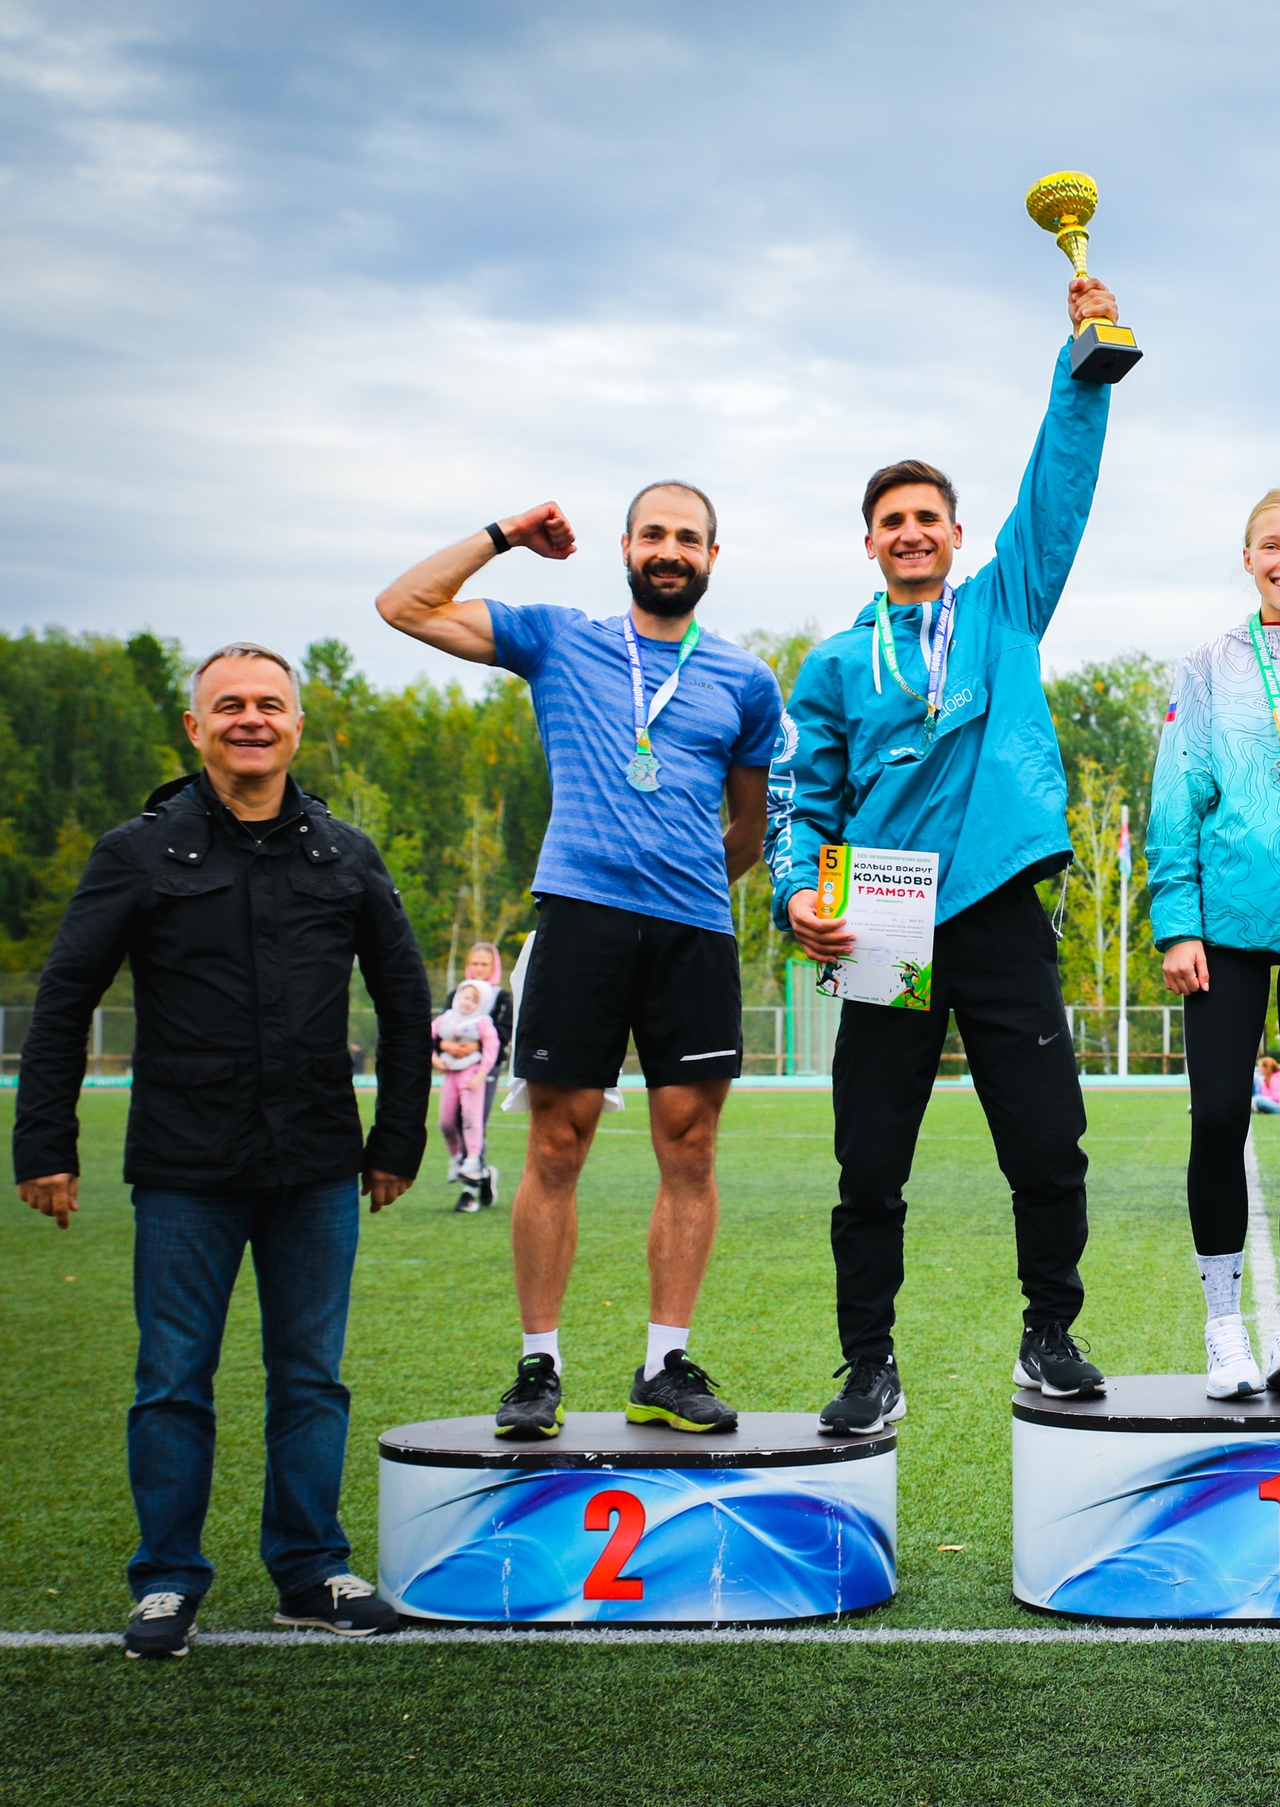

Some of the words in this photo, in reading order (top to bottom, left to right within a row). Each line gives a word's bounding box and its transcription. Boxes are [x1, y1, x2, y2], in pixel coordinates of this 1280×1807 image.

[937, 609, 950, 635] ВОКРУГ
[628, 641, 641, 667] ВОКРУГ
[931, 634, 945, 672] КОЛЬЦОВО
[1253, 630, 1271, 667] КОЛЬЦОВО
[632, 667, 644, 707] КОЛЬЦОВО
[1264, 668, 1279, 695] ВОКРУГ
[825, 849, 838, 869] 5
[854, 863, 893, 871] КОЛЬЦО
[895, 865, 933, 874] ВОКРУГ
[853, 873, 933, 886] КОЛЬЦОВО
[857, 886, 926, 899] ГРАМОТА
[583, 1490, 647, 1601] 2
